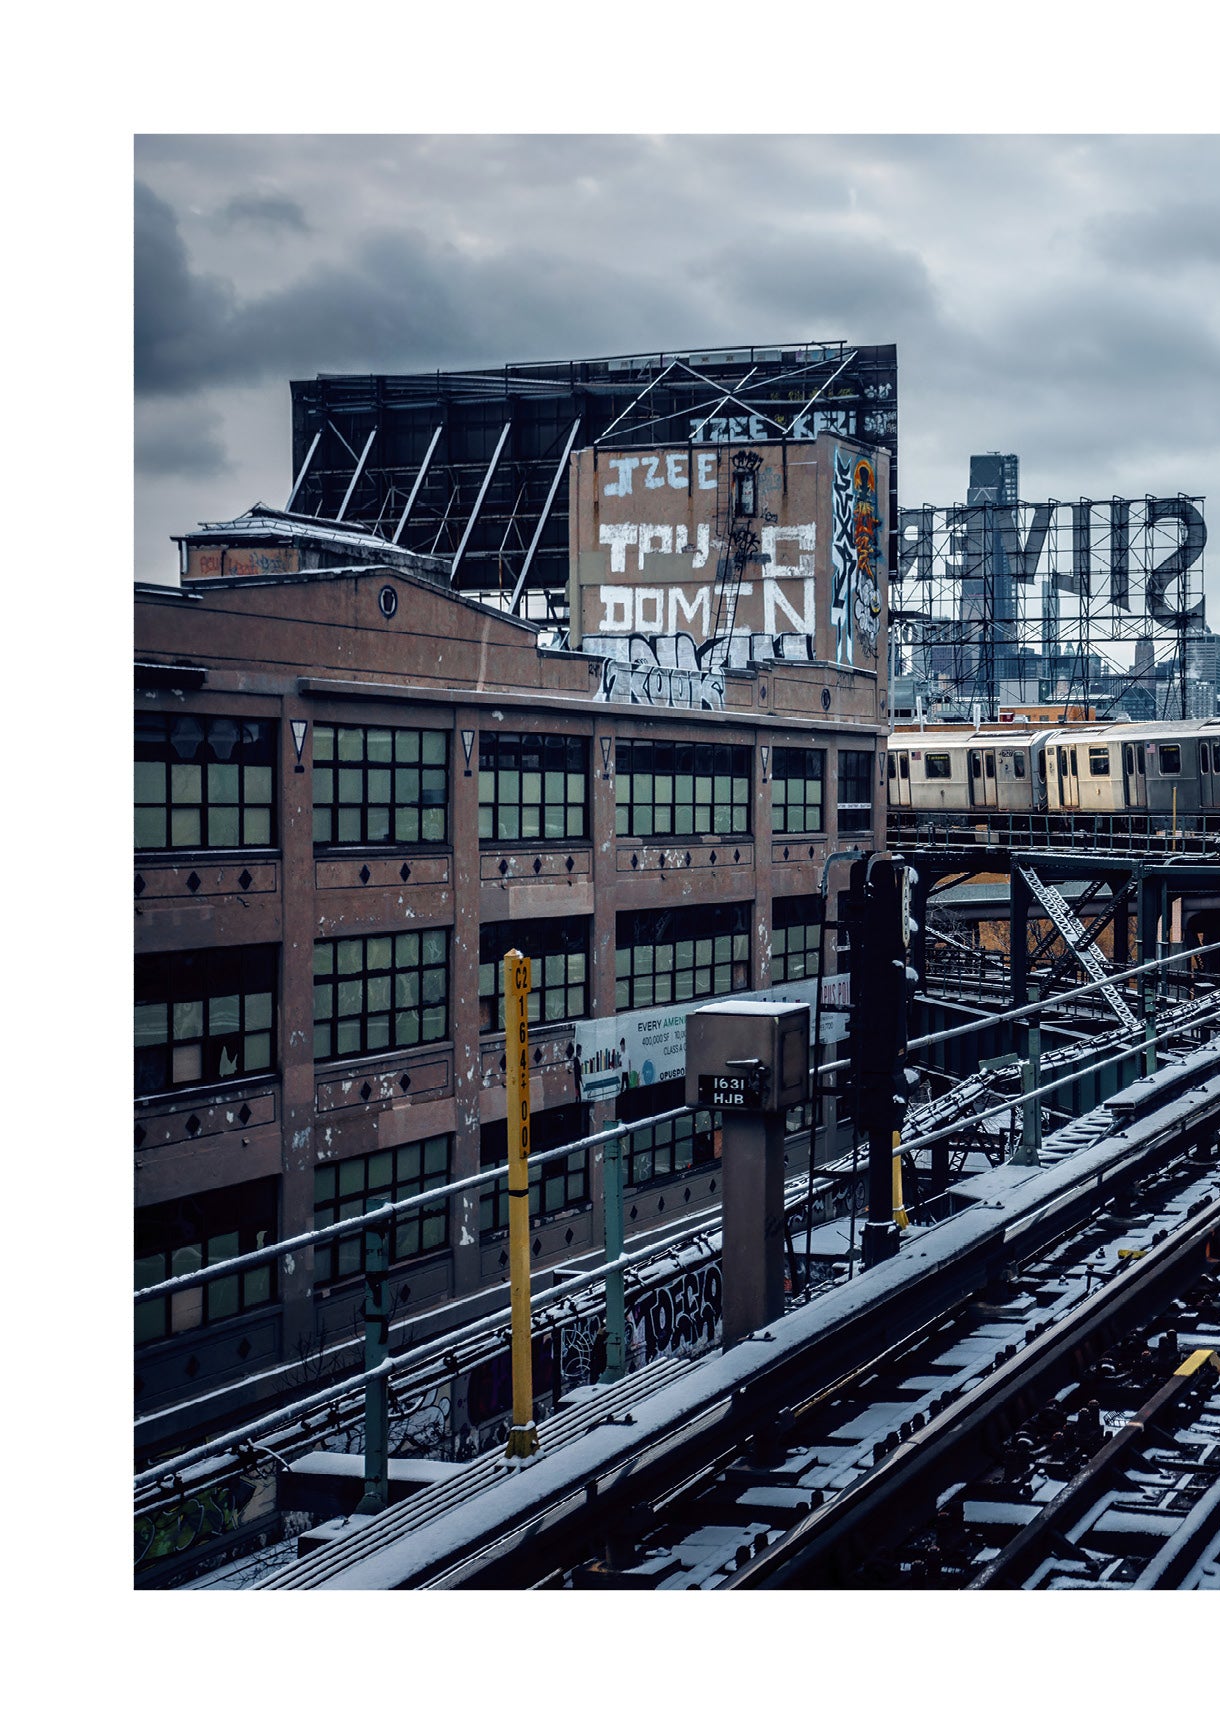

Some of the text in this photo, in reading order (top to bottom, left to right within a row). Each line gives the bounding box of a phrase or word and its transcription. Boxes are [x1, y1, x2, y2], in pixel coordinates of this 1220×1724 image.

[515, 966, 528, 990] C2
[637, 1020, 661, 1032] EVERY
[664, 1044, 679, 1056] CLASS
[714, 1078, 745, 1091] 1631
[714, 1093, 745, 1104] HJB
